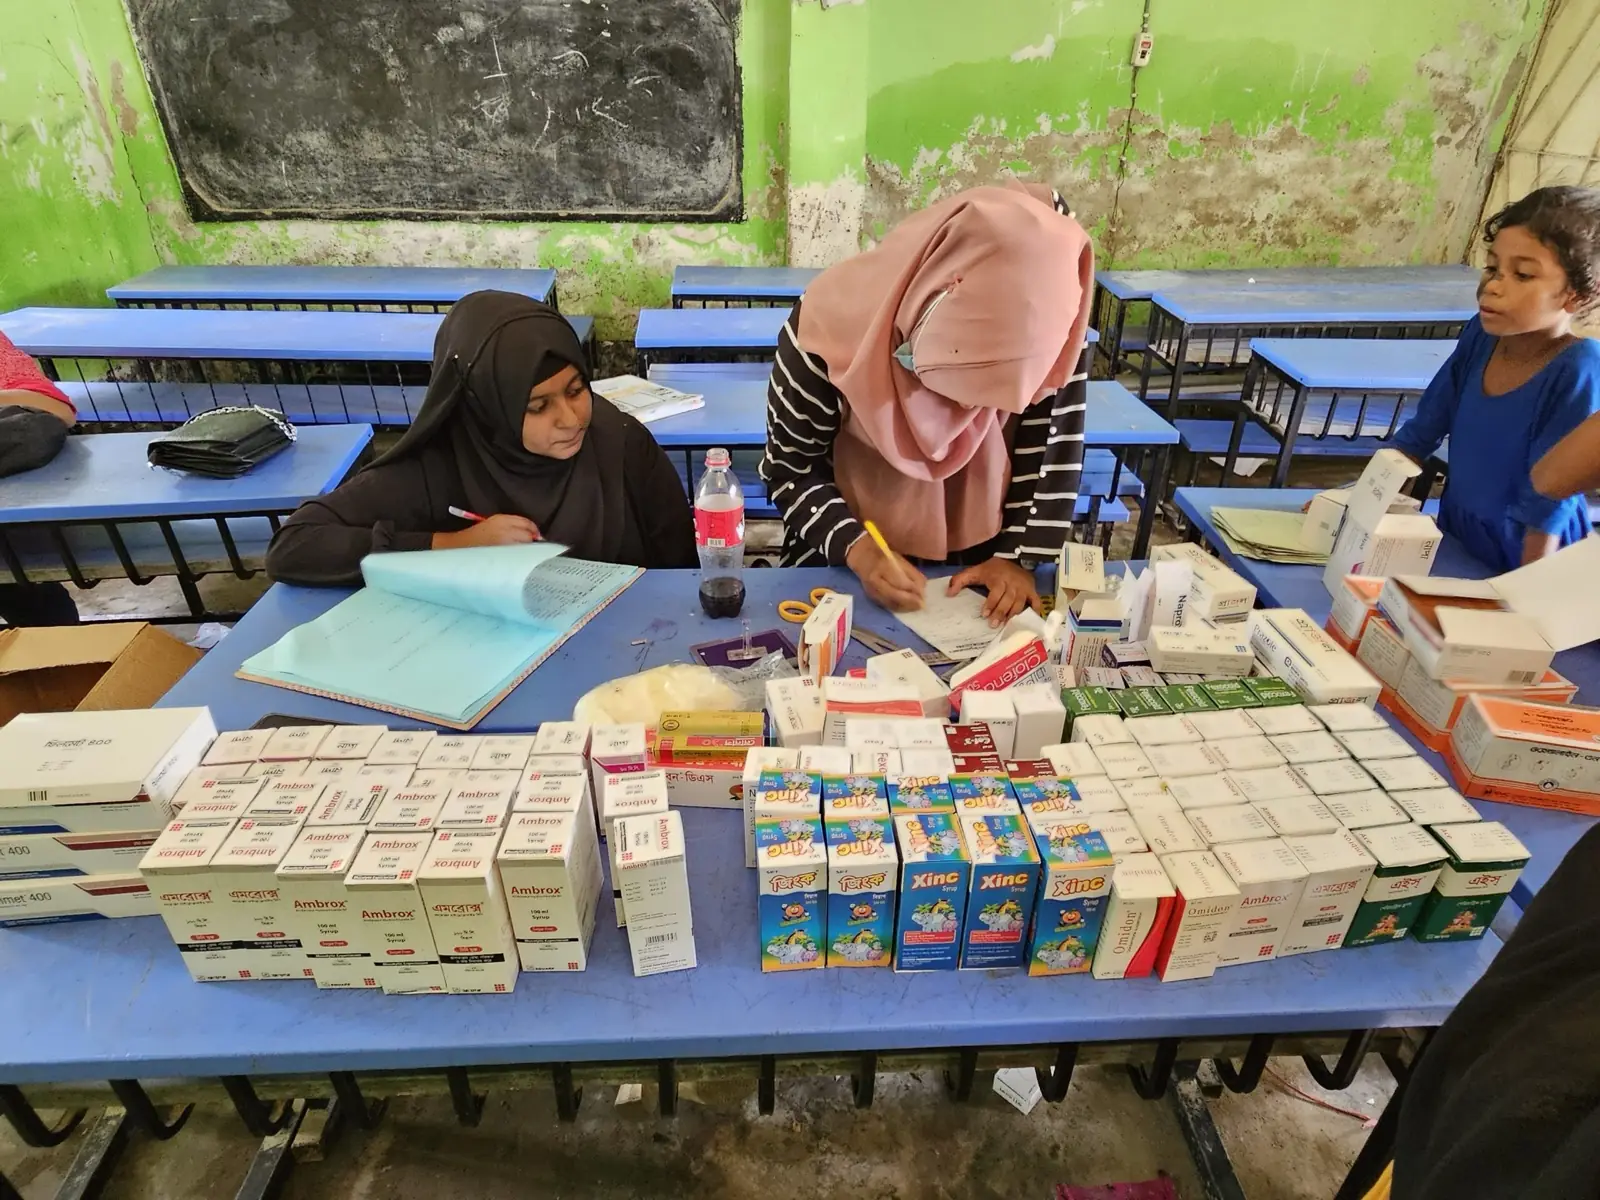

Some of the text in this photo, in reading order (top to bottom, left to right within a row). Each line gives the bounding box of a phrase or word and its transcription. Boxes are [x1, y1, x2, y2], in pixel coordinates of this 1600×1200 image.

[983, 654, 1041, 691] Clofena
[876, 752, 889, 774] Fexo
[273, 782, 316, 790] Ambrox
[897, 776, 940, 789] Xinc
[394, 793, 438, 801] Ambrox
[527, 796, 571, 805] Ambrox
[765, 788, 809, 803] Xinc
[832, 794, 877, 808] Xinc
[964, 794, 1005, 808] Xinc
[193, 803, 238, 812] Ambrox
[319, 790, 343, 820] Ambrox
[1031, 796, 1076, 812] Xinc
[518, 818, 563, 826] Ambrox
[1261, 807, 1281, 829] Ambrox
[305, 833, 351, 841] Ambrox
[659, 819, 670, 850] Ambrox
[906, 821, 933, 853] Xinc
[973, 821, 1000, 855] Xinc
[1045, 824, 1091, 840] Xinc
[1440, 828, 1452, 839] Ace
[372, 840, 420, 849] Ambrox
[1343, 833, 1366, 857] Ambrox
[1359, 833, 1373, 845] Ace
[8, 846, 31, 856] 400
[159, 848, 208, 858] Ambrox
[230, 847, 277, 857] Ambrox
[767, 838, 814, 857] Xinc
[836, 840, 884, 856] Xinc
[433, 860, 481, 869] Ambrox
[621, 862, 648, 870] Ambrox
[1222, 851, 1243, 876] Ambrox
[912, 872, 960, 890] Xinc
[980, 872, 1029, 890] Xinc
[1052, 877, 1105, 897] Xinc
[29, 892, 52, 902] 400
[511, 886, 560, 895] Ambrox
[294, 900, 345, 909] Ambrox
[1240, 894, 1288, 907] Ambrox
[362, 910, 413, 919] Ambrox
[1188, 906, 1231, 915] Omidon
[1113, 911, 1137, 955] Omidon
